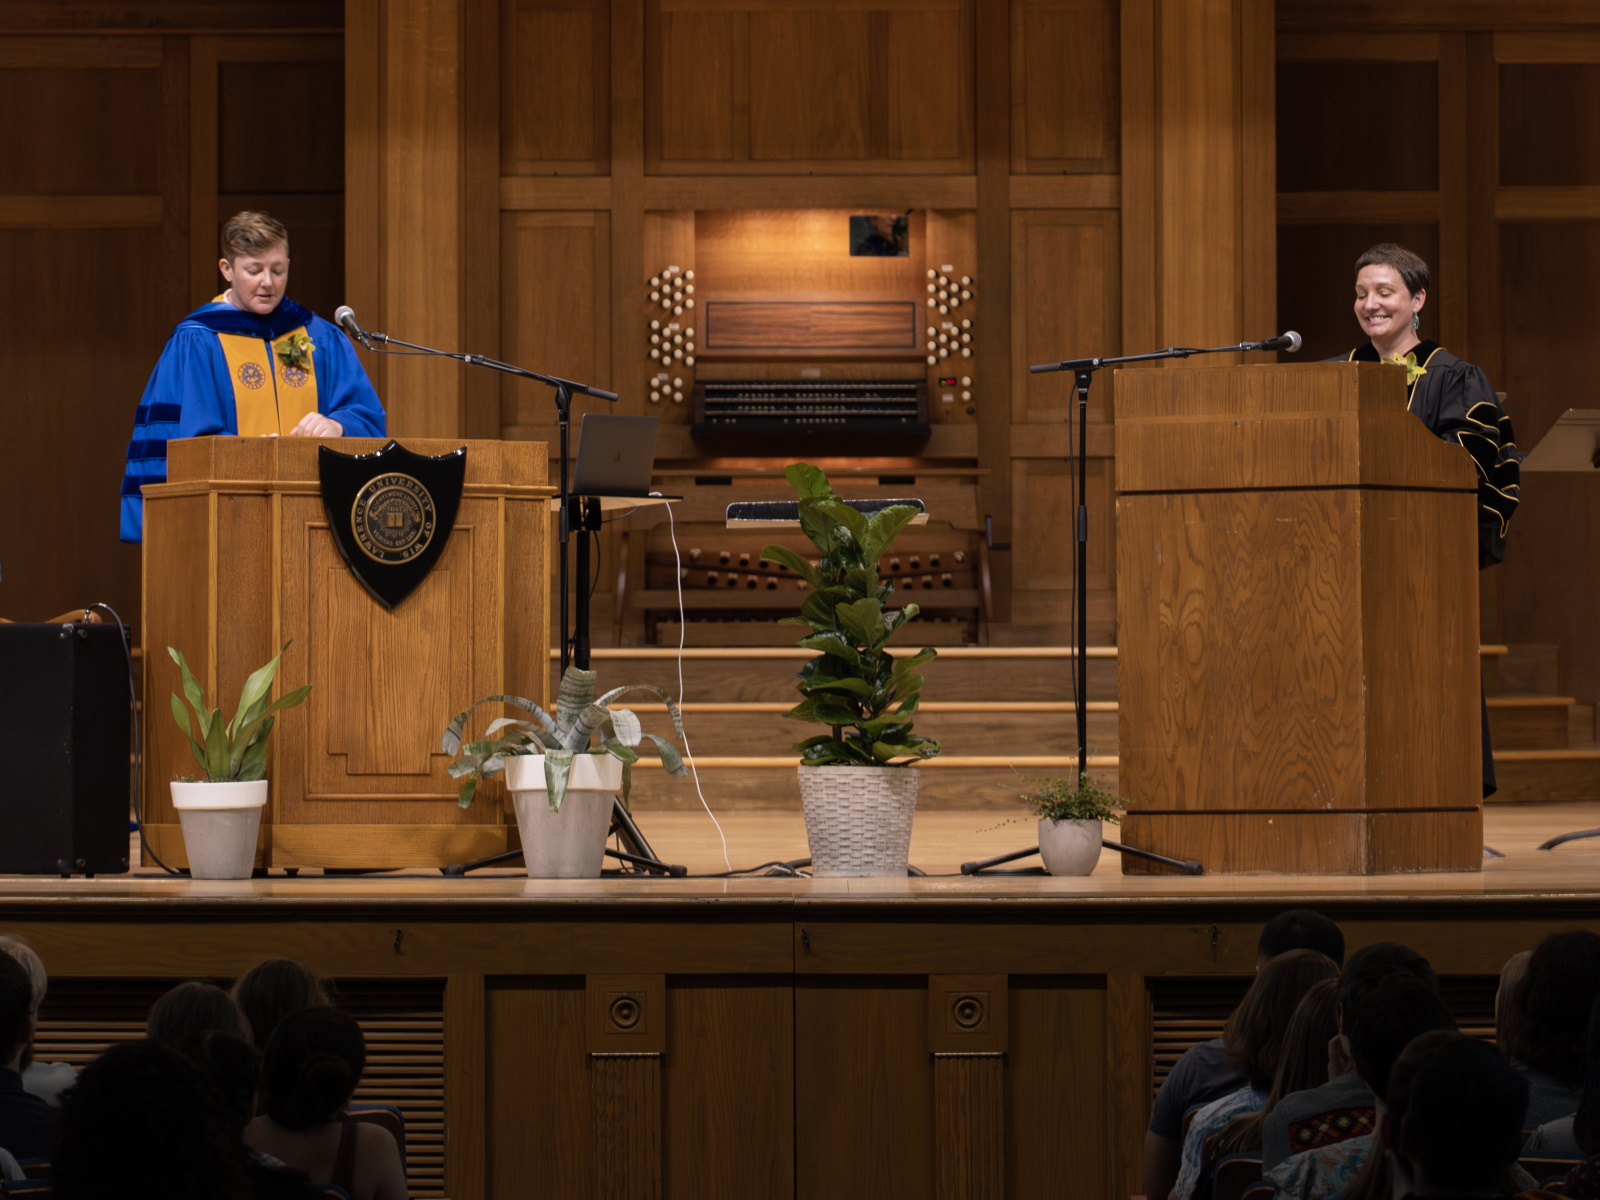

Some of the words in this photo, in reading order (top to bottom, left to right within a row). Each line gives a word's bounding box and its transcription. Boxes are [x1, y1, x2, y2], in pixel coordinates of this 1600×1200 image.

[368, 477, 432, 512] UNIVERSITY
[356, 499, 386, 558] LAWRENCE
[423, 522, 432, 538] OF
